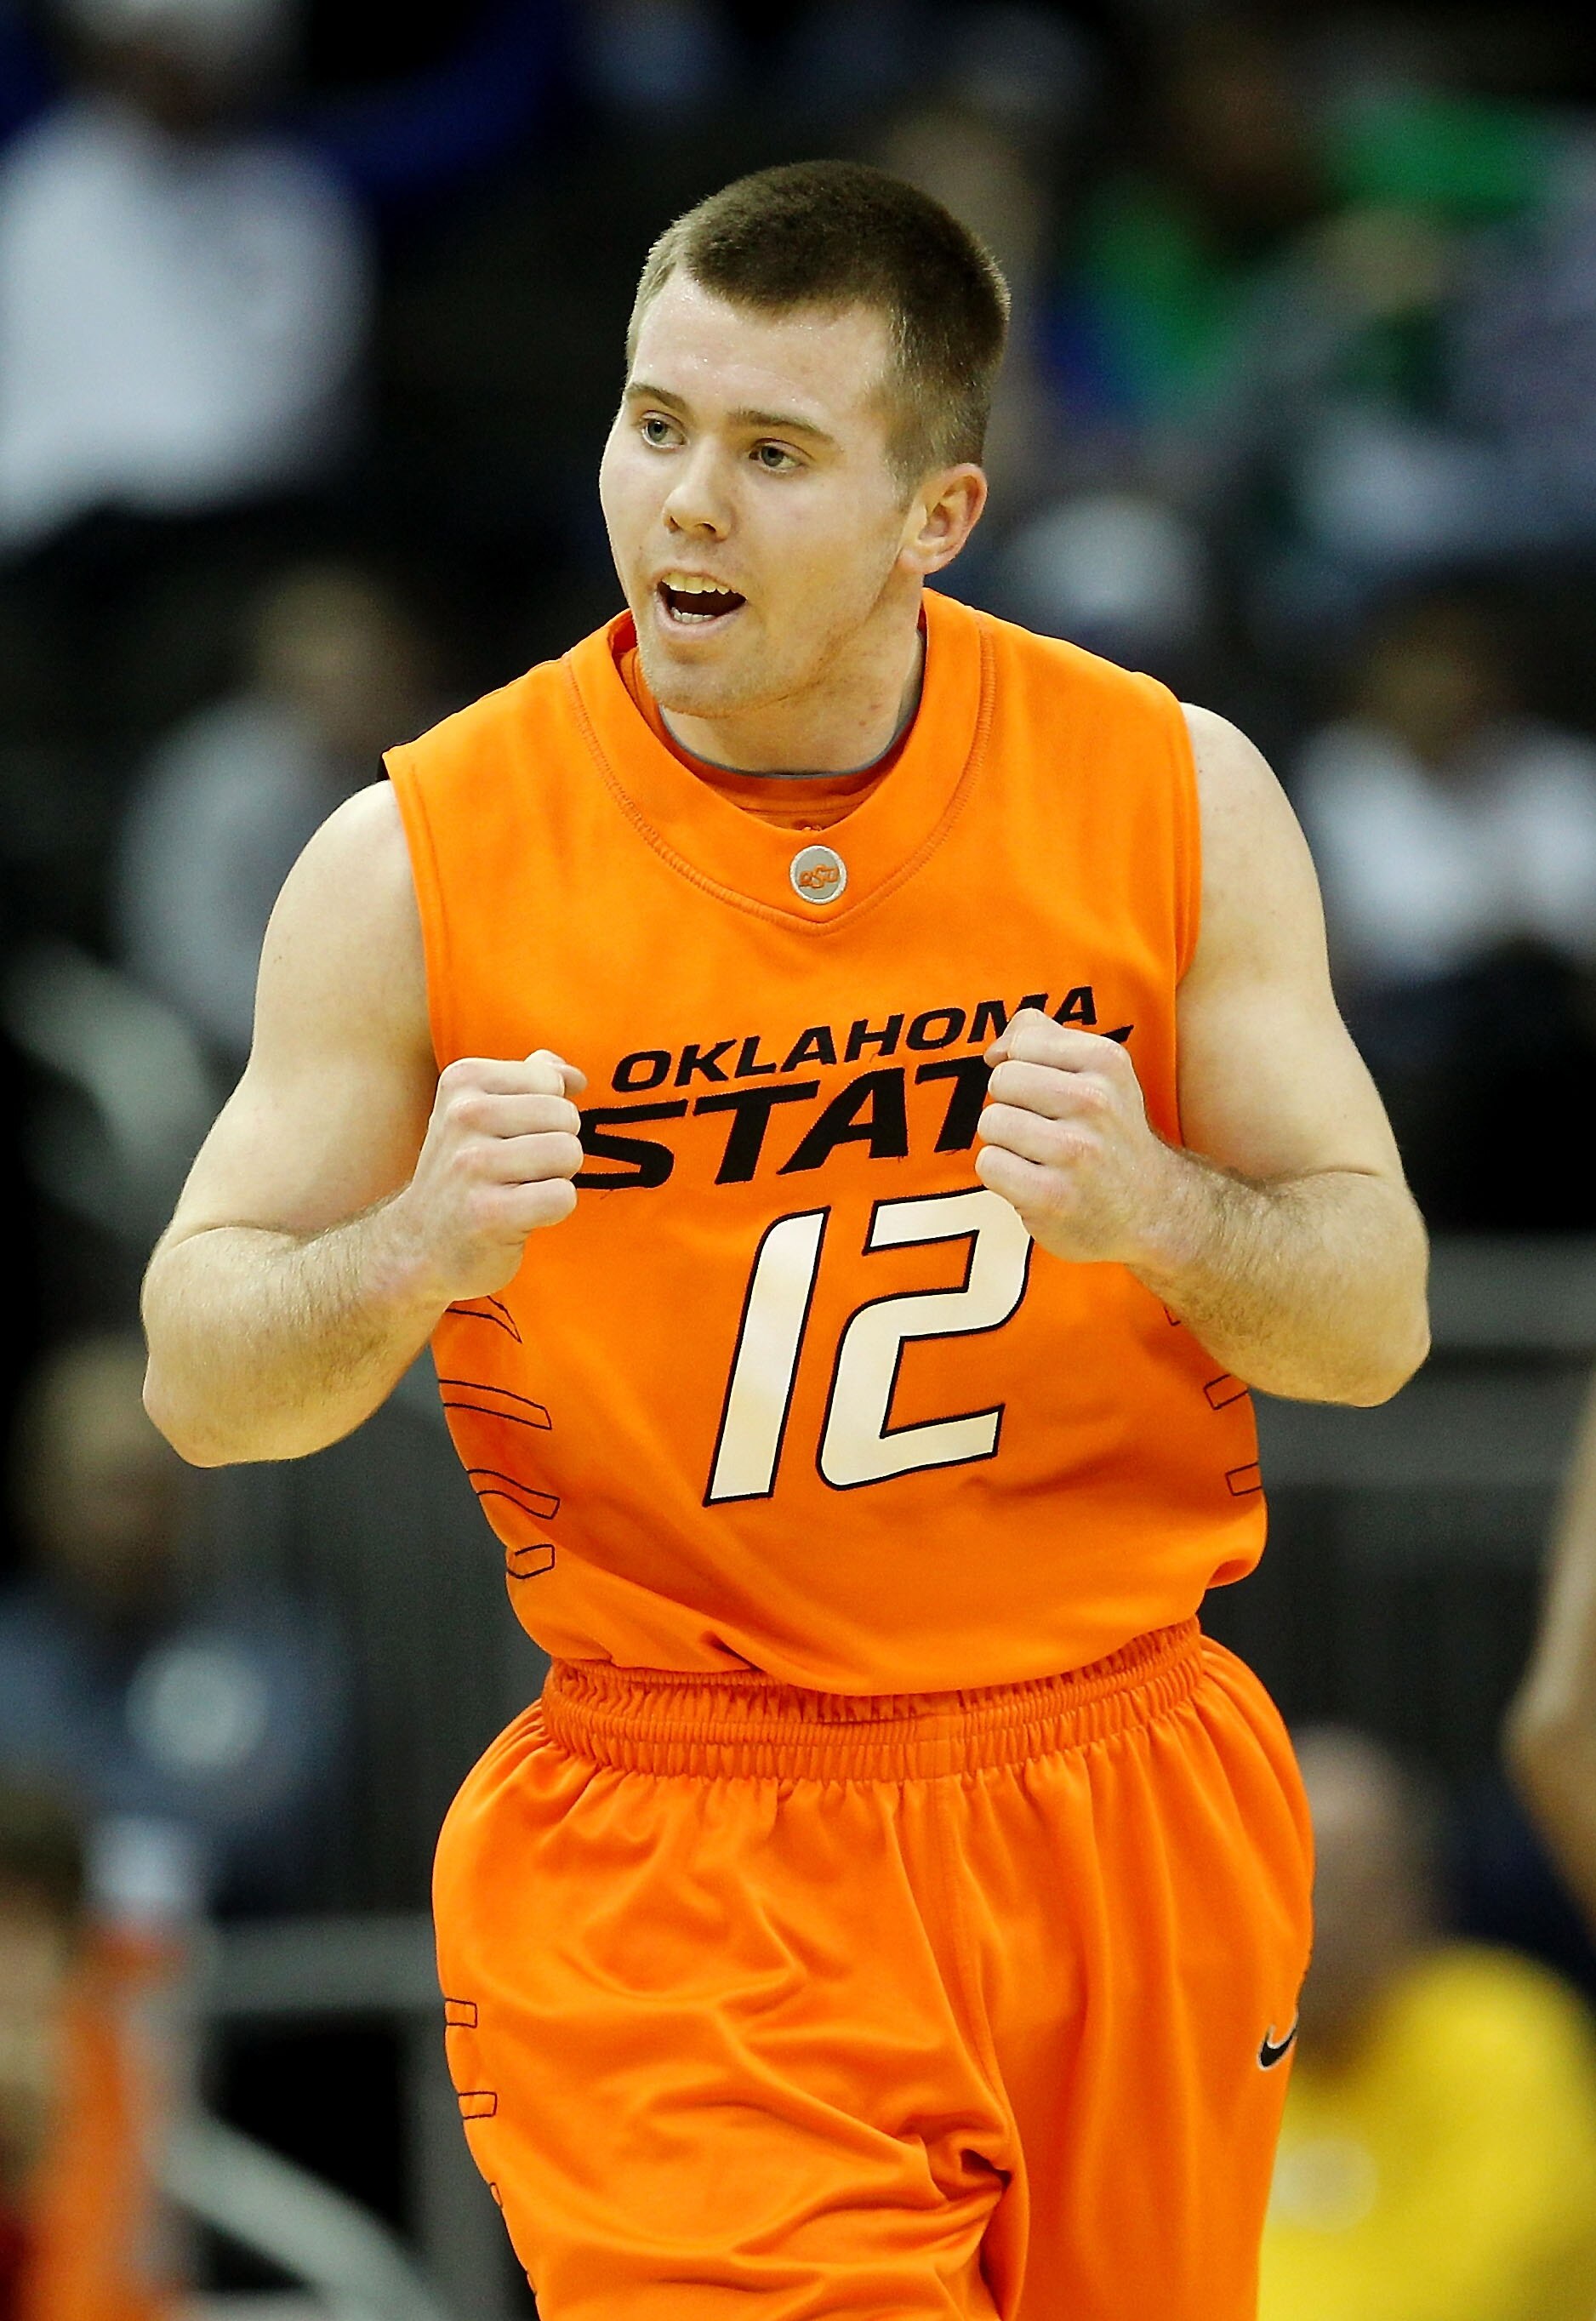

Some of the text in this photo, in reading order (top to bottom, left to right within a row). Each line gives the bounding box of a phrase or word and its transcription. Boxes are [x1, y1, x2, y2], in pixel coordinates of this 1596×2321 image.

[576, 1024, 1135, 1190] STAT
[611, 985, 1098, 1093] OKLAHOMA
[702, 1184, 1035, 1507] 12
